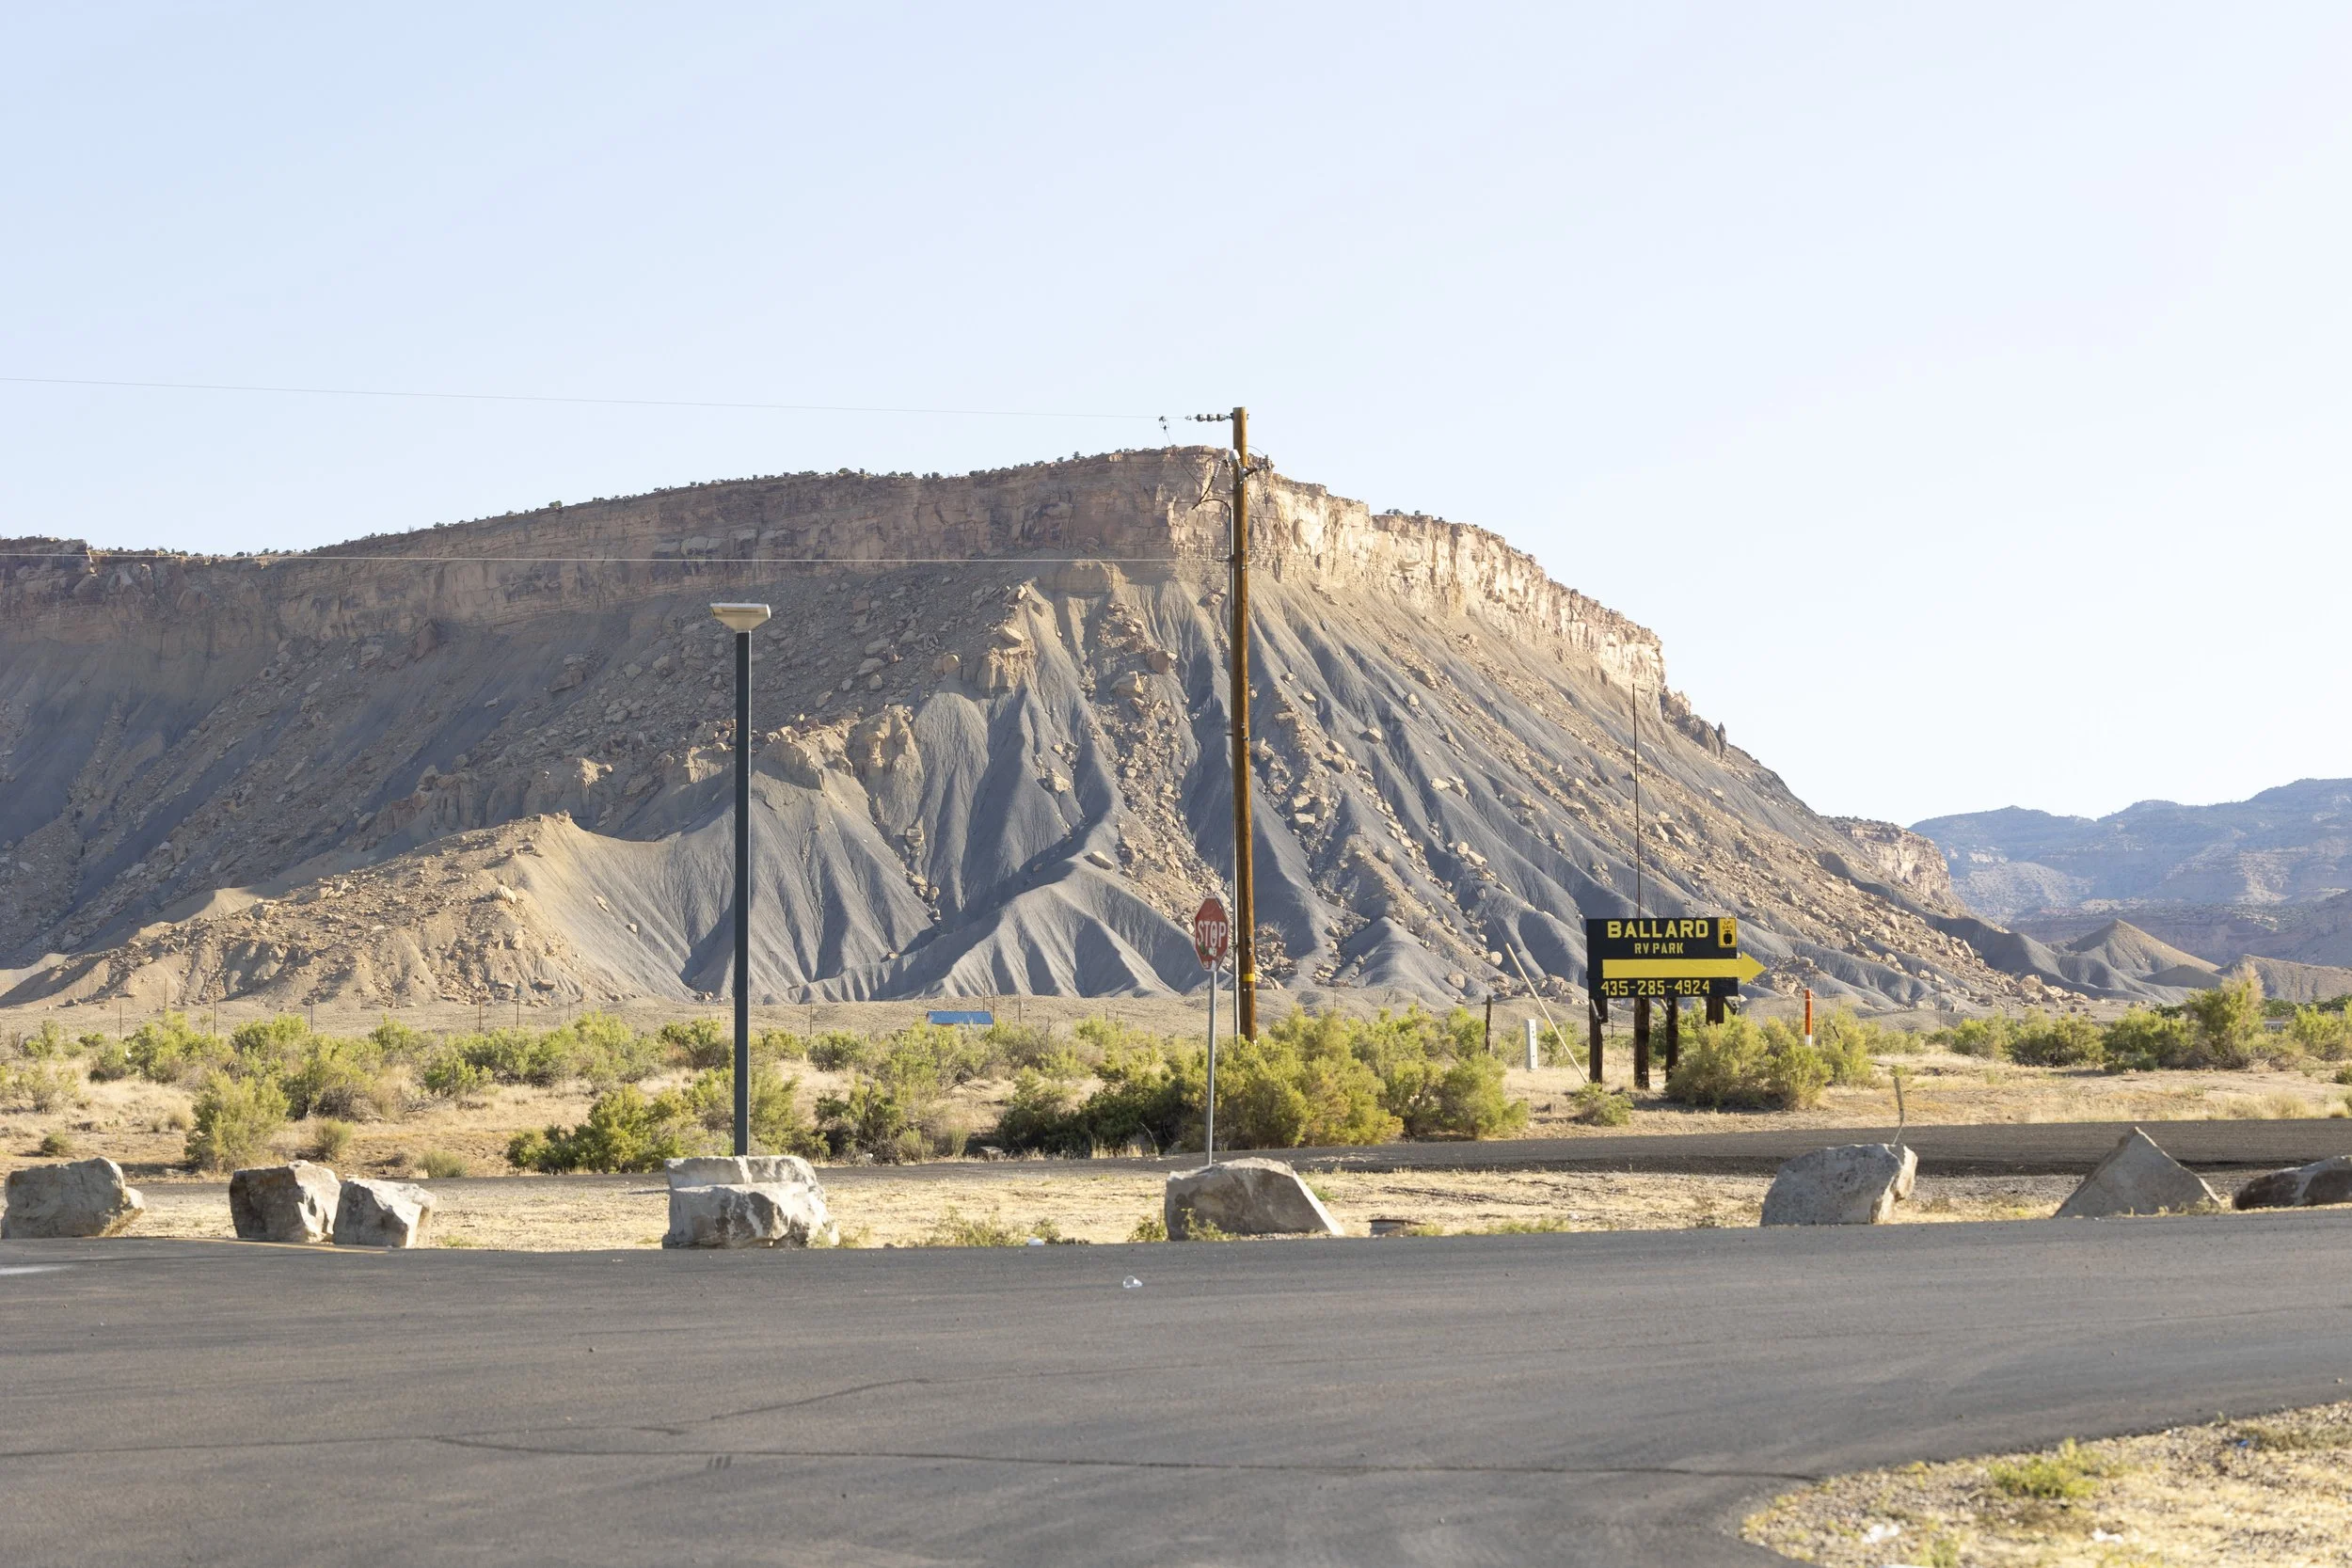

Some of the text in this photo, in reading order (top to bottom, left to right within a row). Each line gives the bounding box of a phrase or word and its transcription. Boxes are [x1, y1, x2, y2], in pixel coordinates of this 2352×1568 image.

[1197, 920, 1227, 948] STOP
[1607, 919, 1709, 939] BALLARD
[1634, 942, 1684, 955] RV PARK
[1600, 979, 1710, 996] 435-285-4924
